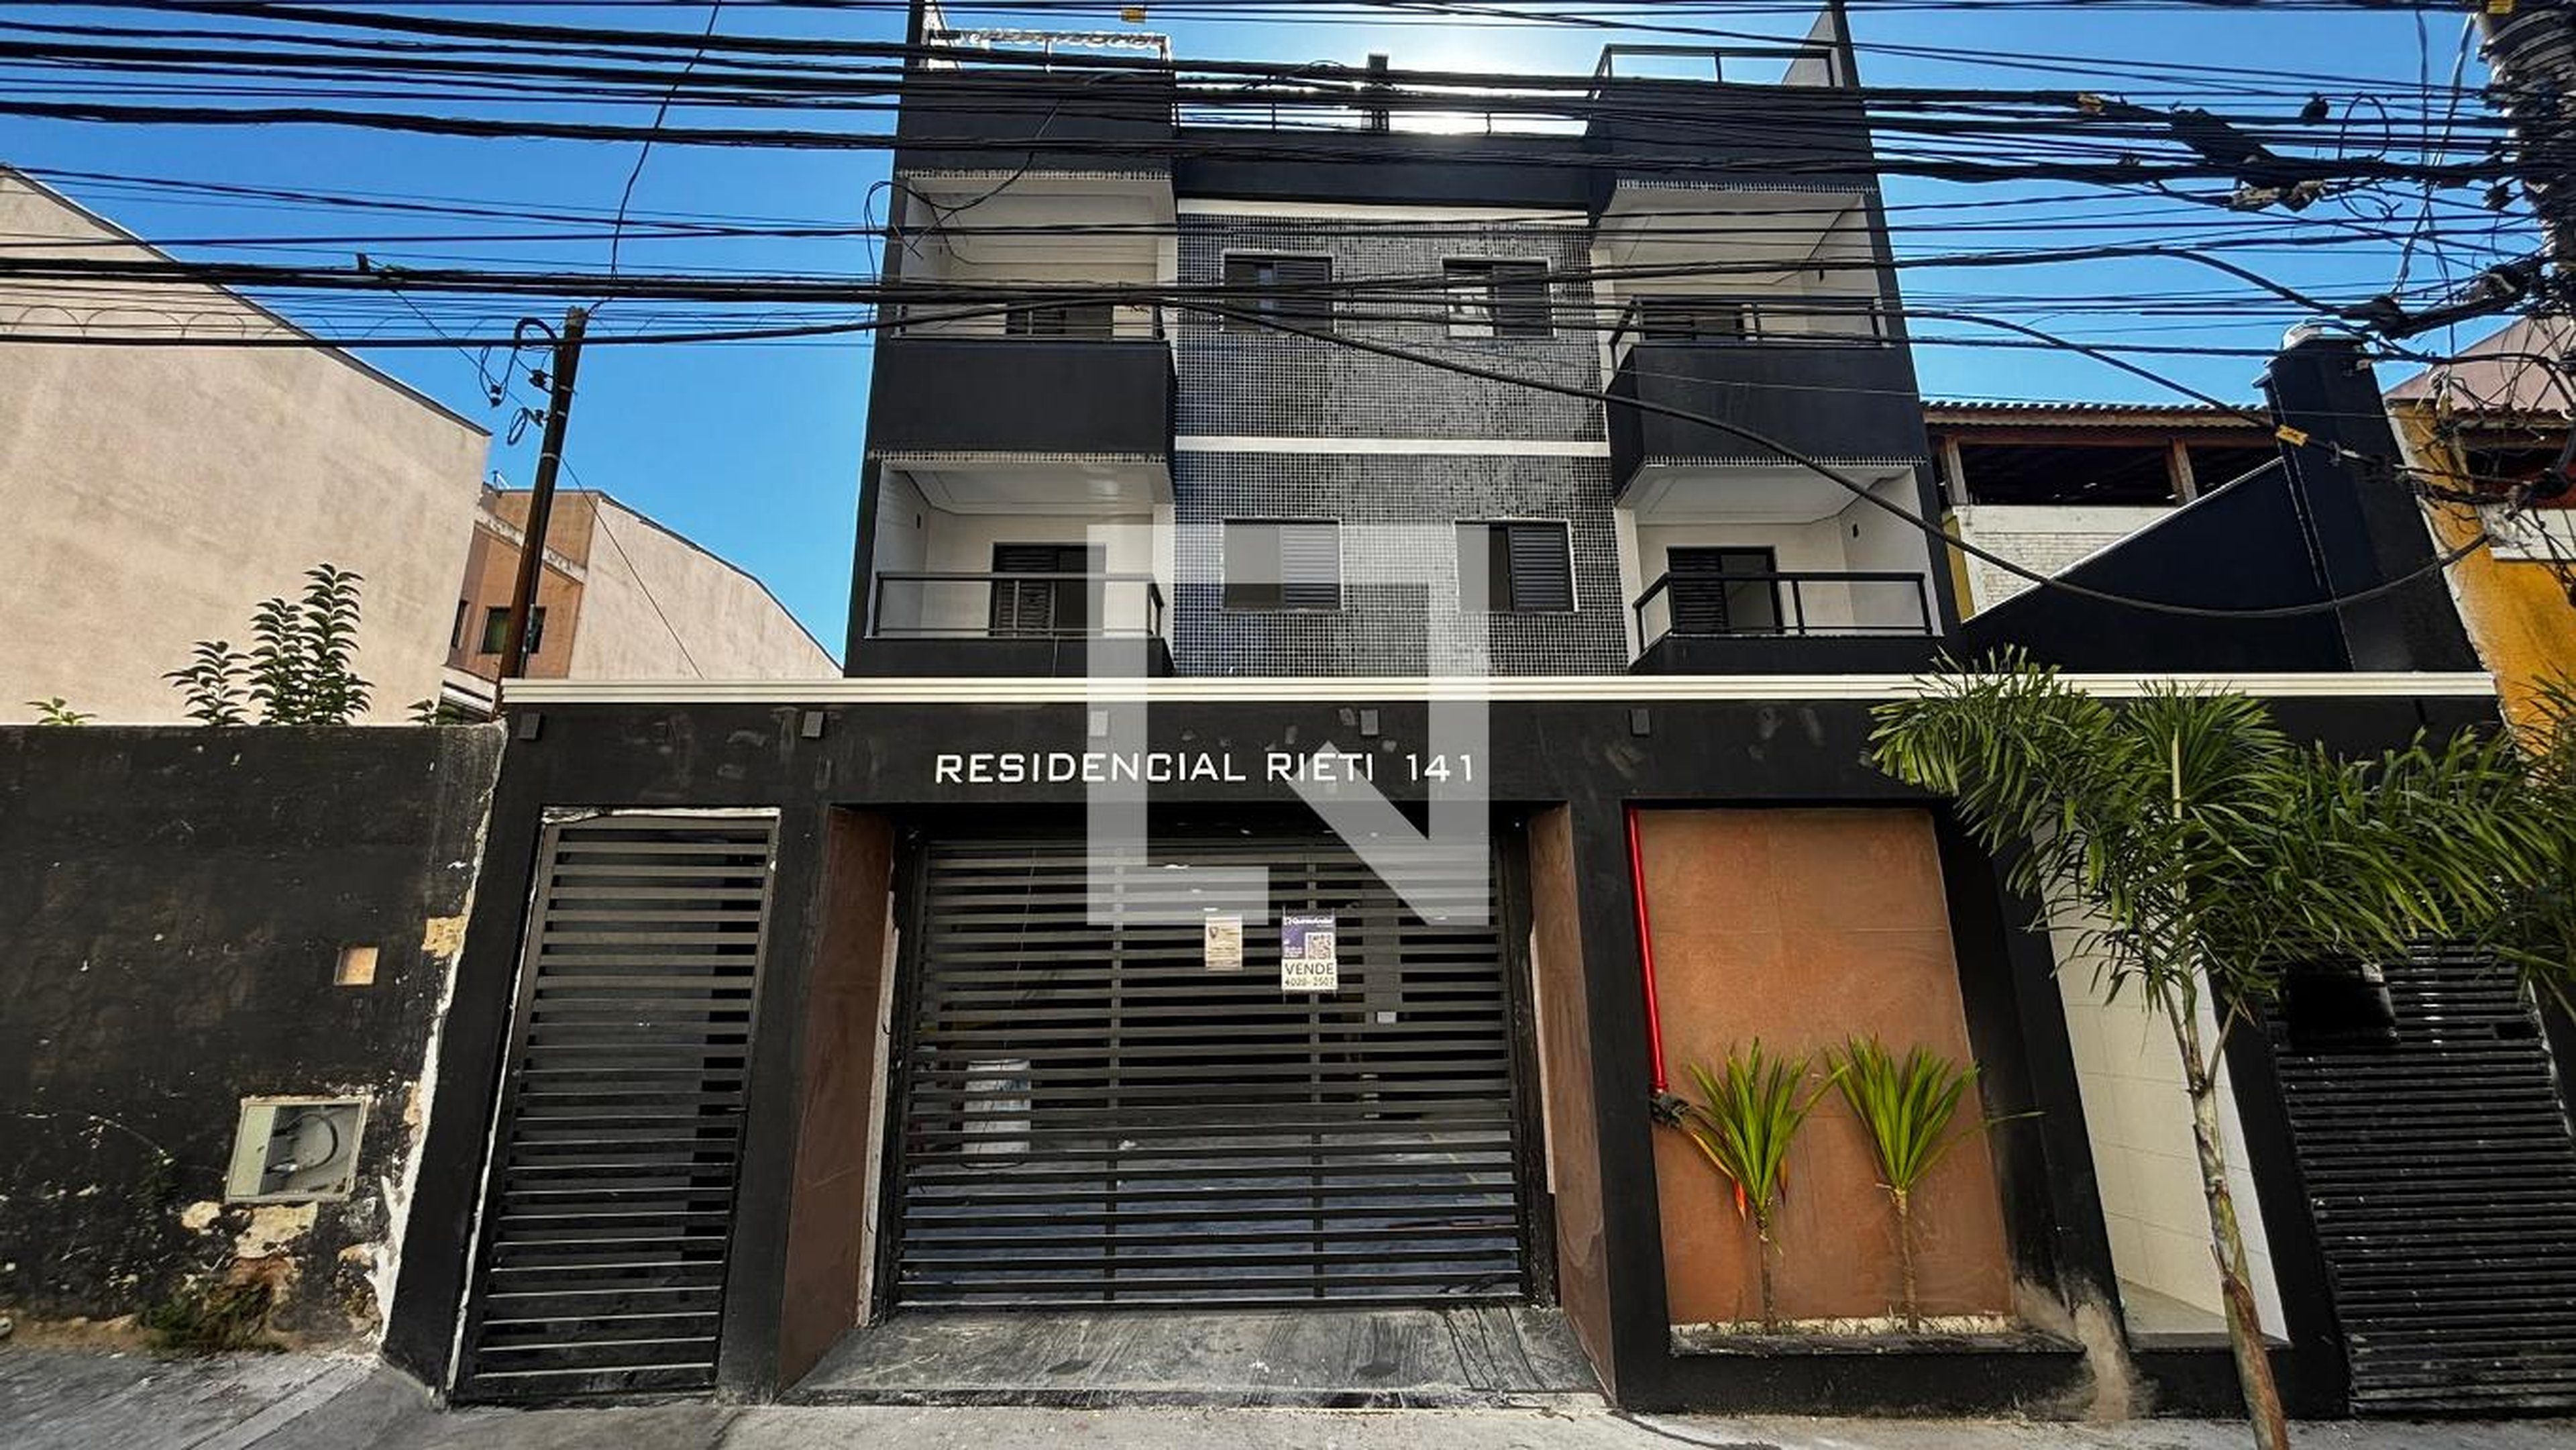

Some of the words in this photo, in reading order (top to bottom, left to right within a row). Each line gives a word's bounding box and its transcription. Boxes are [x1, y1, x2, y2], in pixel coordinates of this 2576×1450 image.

[935, 752, 1246, 783] RESIDENCIAL
[1267, 752, 1373, 782] RIETI
[1405, 753, 1473, 782] 141
[1285, 962, 1334, 975] VENDE
